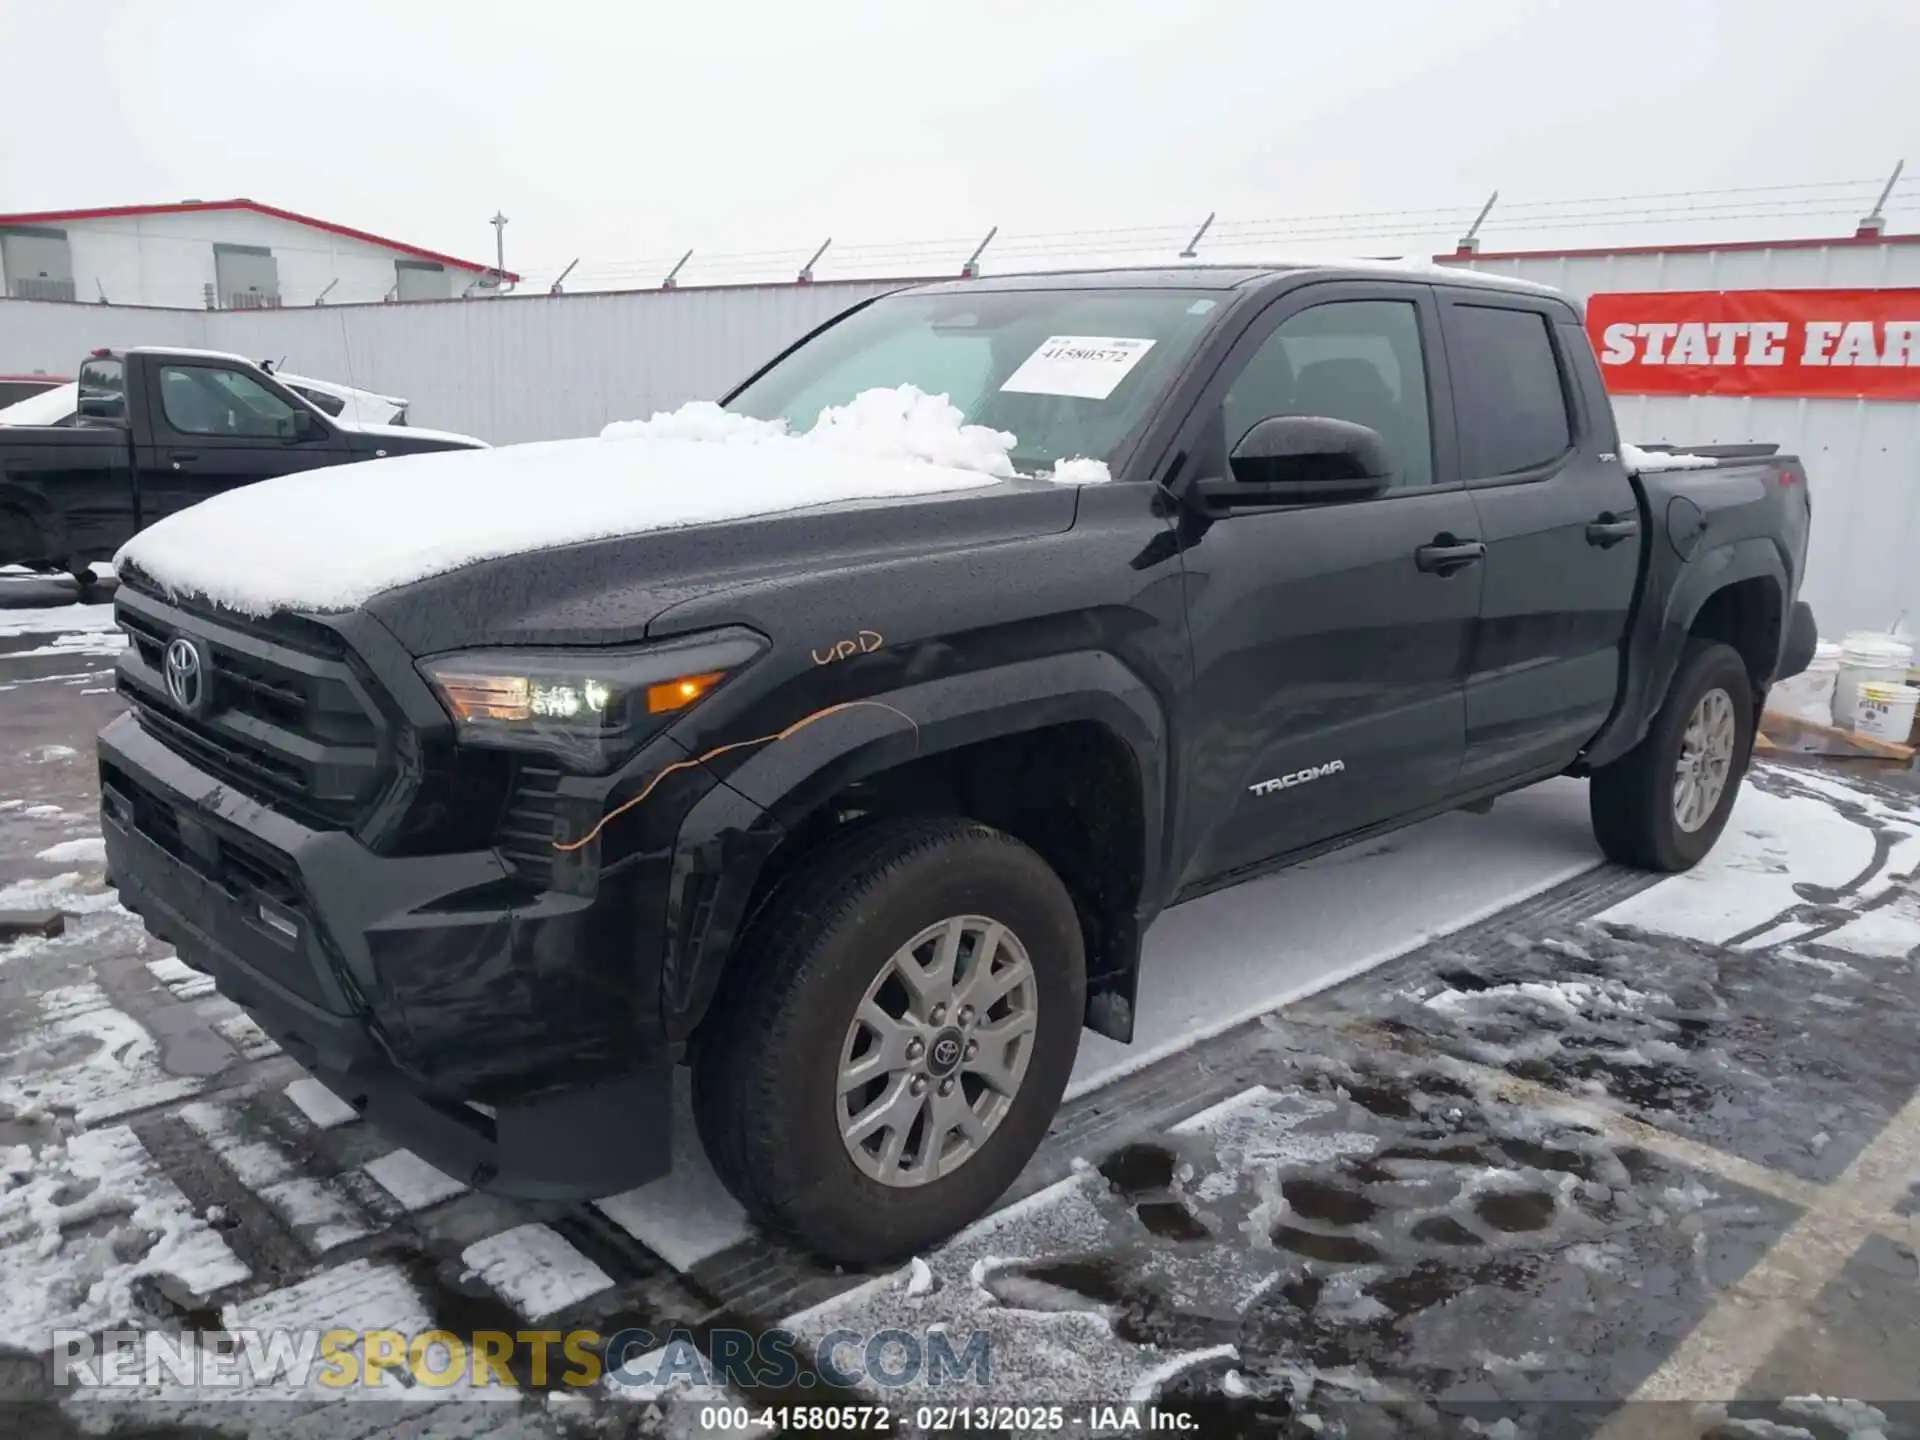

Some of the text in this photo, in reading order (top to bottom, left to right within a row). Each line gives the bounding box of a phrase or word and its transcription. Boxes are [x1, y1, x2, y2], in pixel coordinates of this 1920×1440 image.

[1601, 322, 1788, 366] STATE
[811, 629, 883, 665] UPD
[1248, 759, 1345, 796] TACOMA
